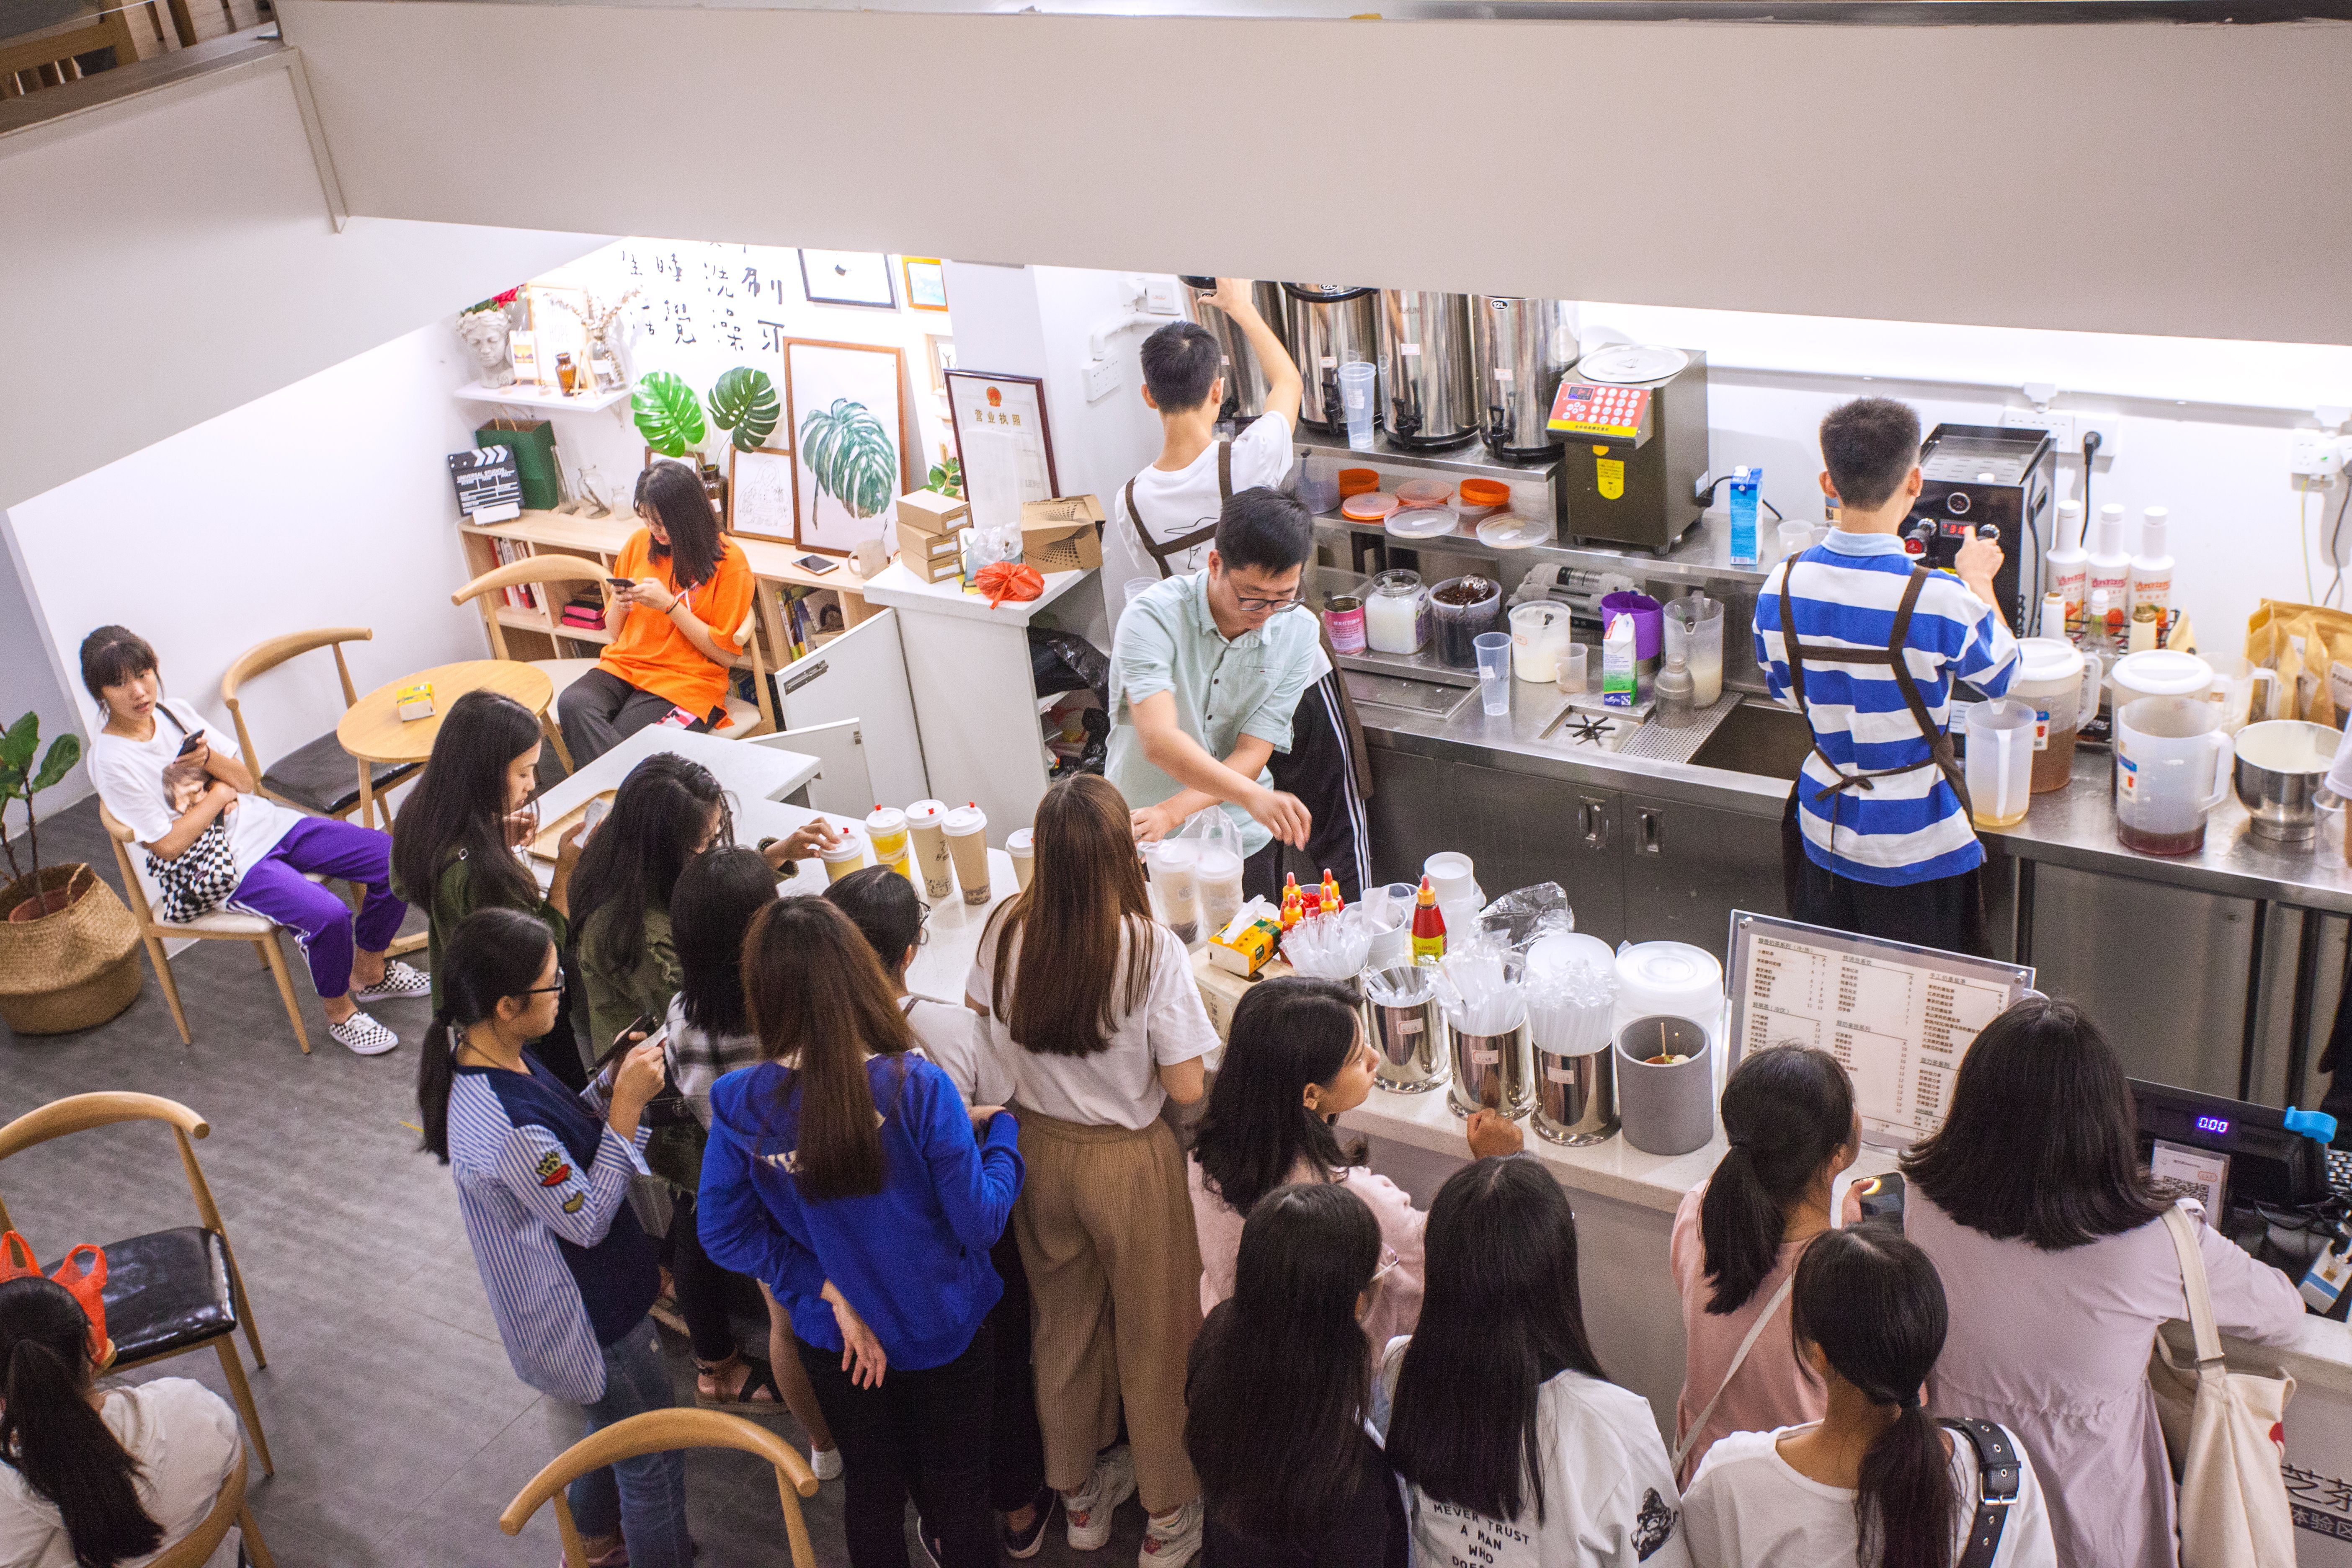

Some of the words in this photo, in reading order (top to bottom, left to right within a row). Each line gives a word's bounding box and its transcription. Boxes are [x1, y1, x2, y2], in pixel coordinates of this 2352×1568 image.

[975, 409, 1021, 426] 营业执照
[1461, 1524, 1468, 1537] A
[1478, 1529, 1502, 1550] MAN
[1488, 1520, 1529, 1545] TRUST
[1469, 1544, 1494, 1564] WHO
